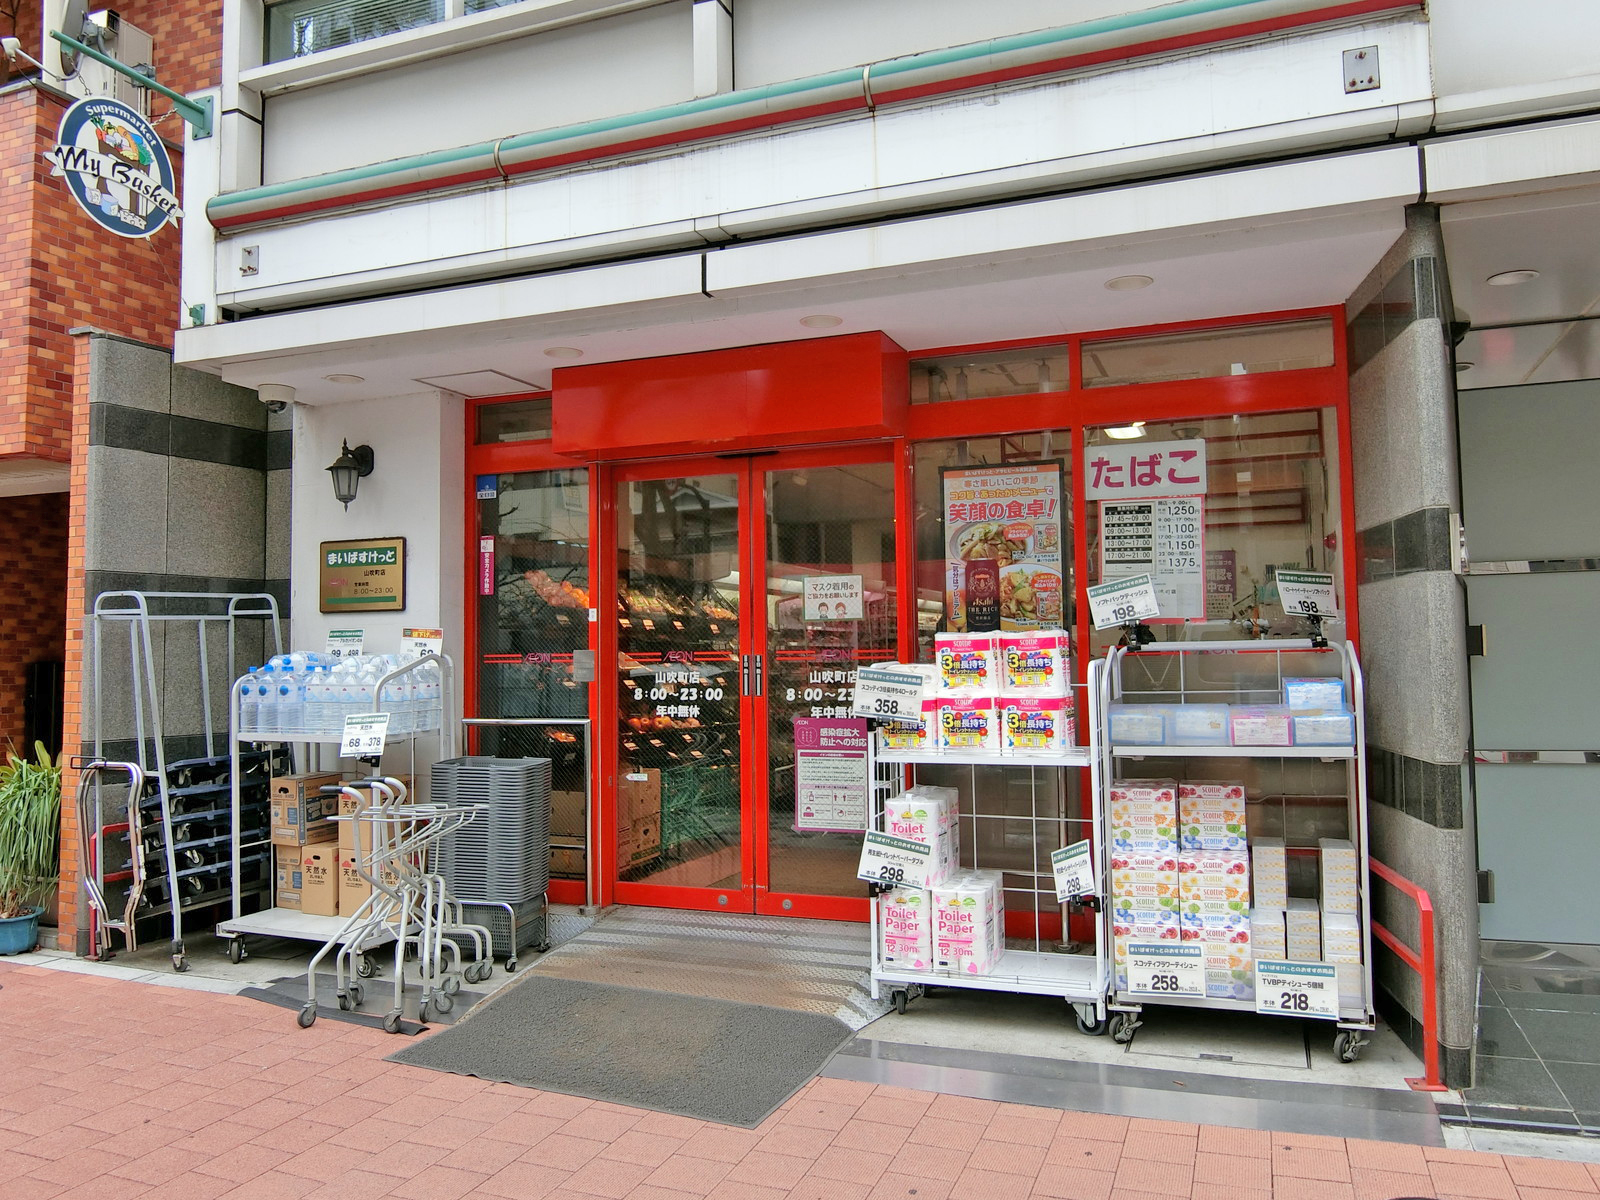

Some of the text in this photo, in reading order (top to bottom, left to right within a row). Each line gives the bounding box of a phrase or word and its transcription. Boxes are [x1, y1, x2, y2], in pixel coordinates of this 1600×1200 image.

[85, 105, 157, 146] Supermarket
[55, 147, 178, 215] My Basket
[1090, 450, 1200, 489] たばこ
[949, 498, 1056, 522] 笑顔の食卓！
[1168, 505, 1195, 516] 1,250
[1106, 514, 1150, 523] 07:45～09:00
[1107, 527, 1150, 535] 09:00～13:00
[1167, 523, 1194, 534] 1,100
[1107, 539, 1150, 547] 13:00～17:00
[1168, 540, 1195, 550] 1,150
[328, 550, 395, 565] まいばすけっと
[1107, 551, 1150, 559] 17:00～21:00
[1169, 557, 1195, 567] 1375
[812, 582, 854, 591] マスク着用の
[807, 592, 859, 600] ご協力をお願いします
[1112, 605, 1136, 621] 198
[1298, 600, 1319, 613] 198
[655, 671, 700, 684] 山吹町店
[809, 670, 858, 684] 山吹町店
[634, 688, 723, 701] 8:00～23:00
[656, 705, 700, 718] 年中無休
[874, 698, 899, 715] 358
[820, 728, 860, 737] 感染症拡大
[349, 737, 381, 747] 68 378
[820, 737, 867, 747] 防止への対応
[891, 822, 924, 834] Toilet
[306, 866, 327, 875] 天然水
[343, 868, 358, 877] 天然
[880, 865, 904, 882] 298
[1066, 876, 1081, 894] 298
[885, 906, 917, 919] Toilet
[938, 909, 972, 923] Toilet
[885, 917, 920, 931] Paper
[938, 920, 974, 935] Paper
[887, 944, 896, 953] 12
[940, 948, 949, 956] 12
[1133, 959, 1198, 969] スコッティフラワーティシュー
[1151, 974, 1179, 992] 258
[1280, 991, 1309, 1012] 218
